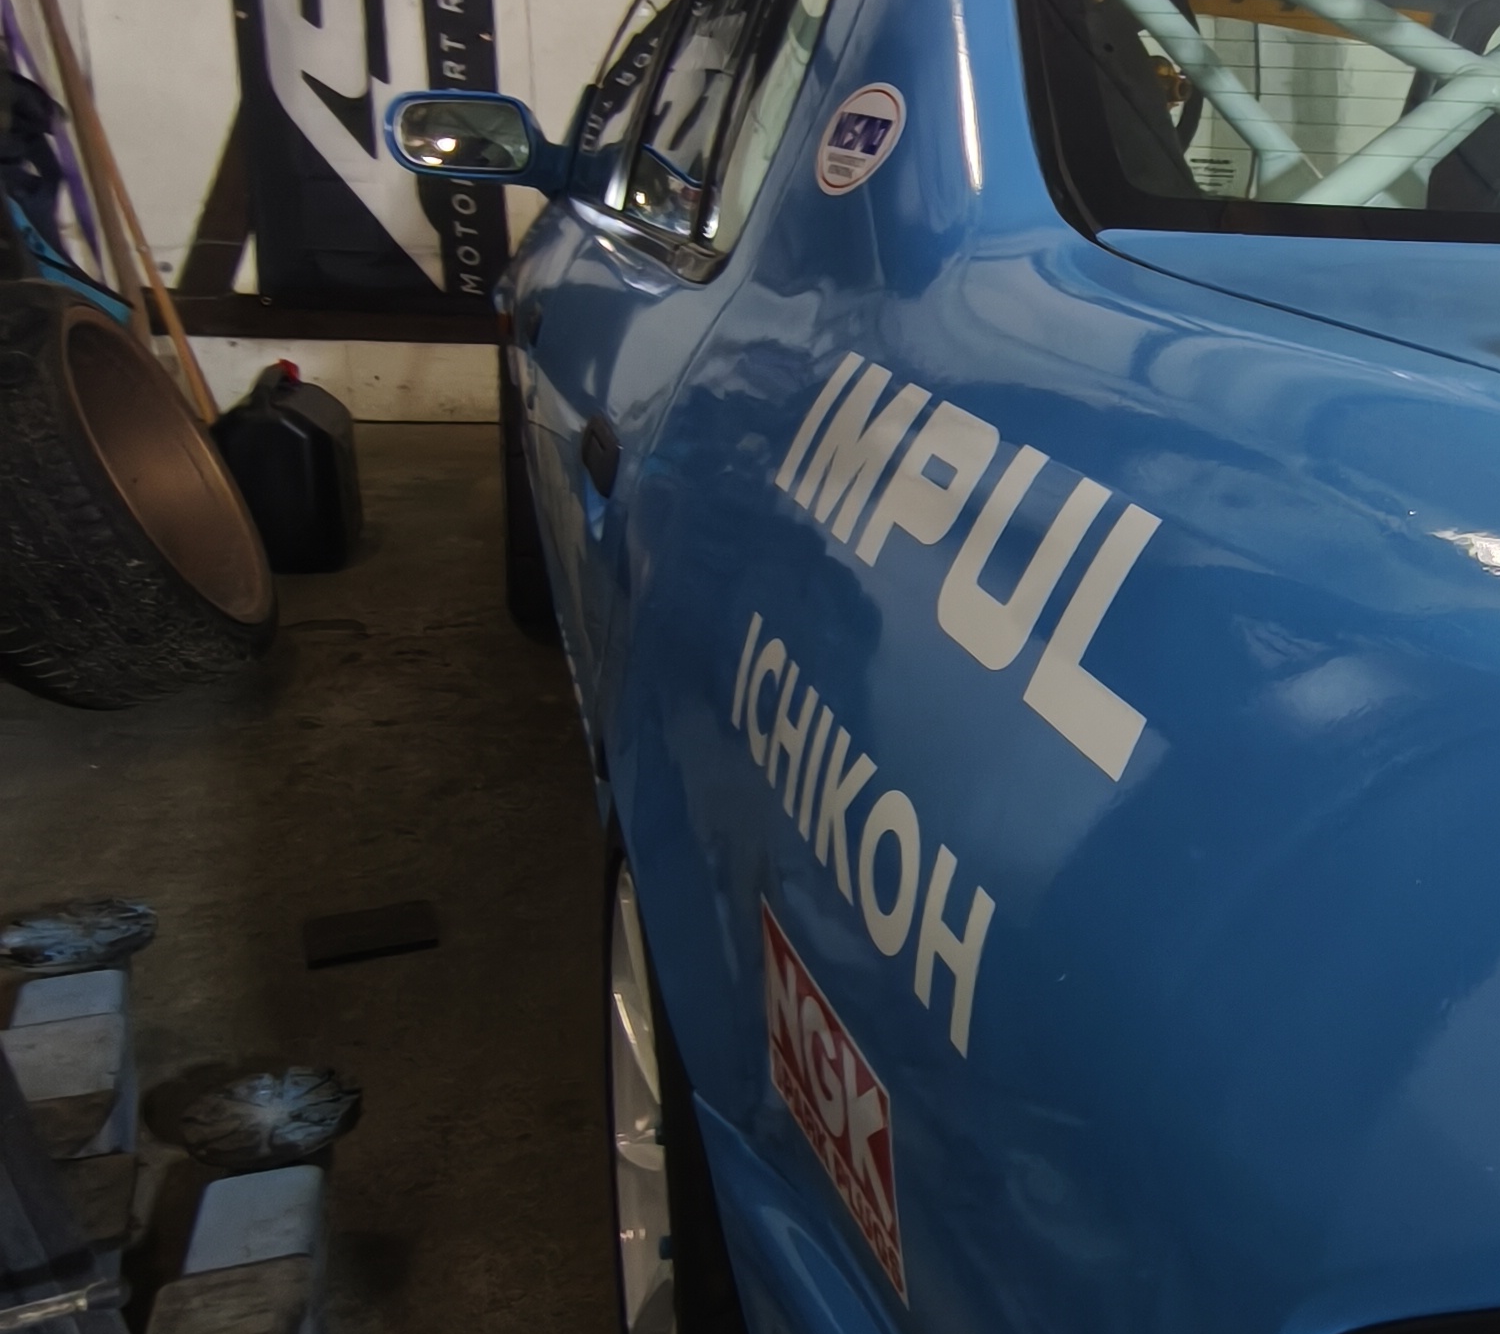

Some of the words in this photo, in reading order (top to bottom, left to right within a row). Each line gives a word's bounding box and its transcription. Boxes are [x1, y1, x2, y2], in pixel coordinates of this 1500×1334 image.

[774, 351, 1162, 782] IMPUL
[731, 611, 996, 1059] ICHIKOH
[766, 942, 895, 1239] NGK
